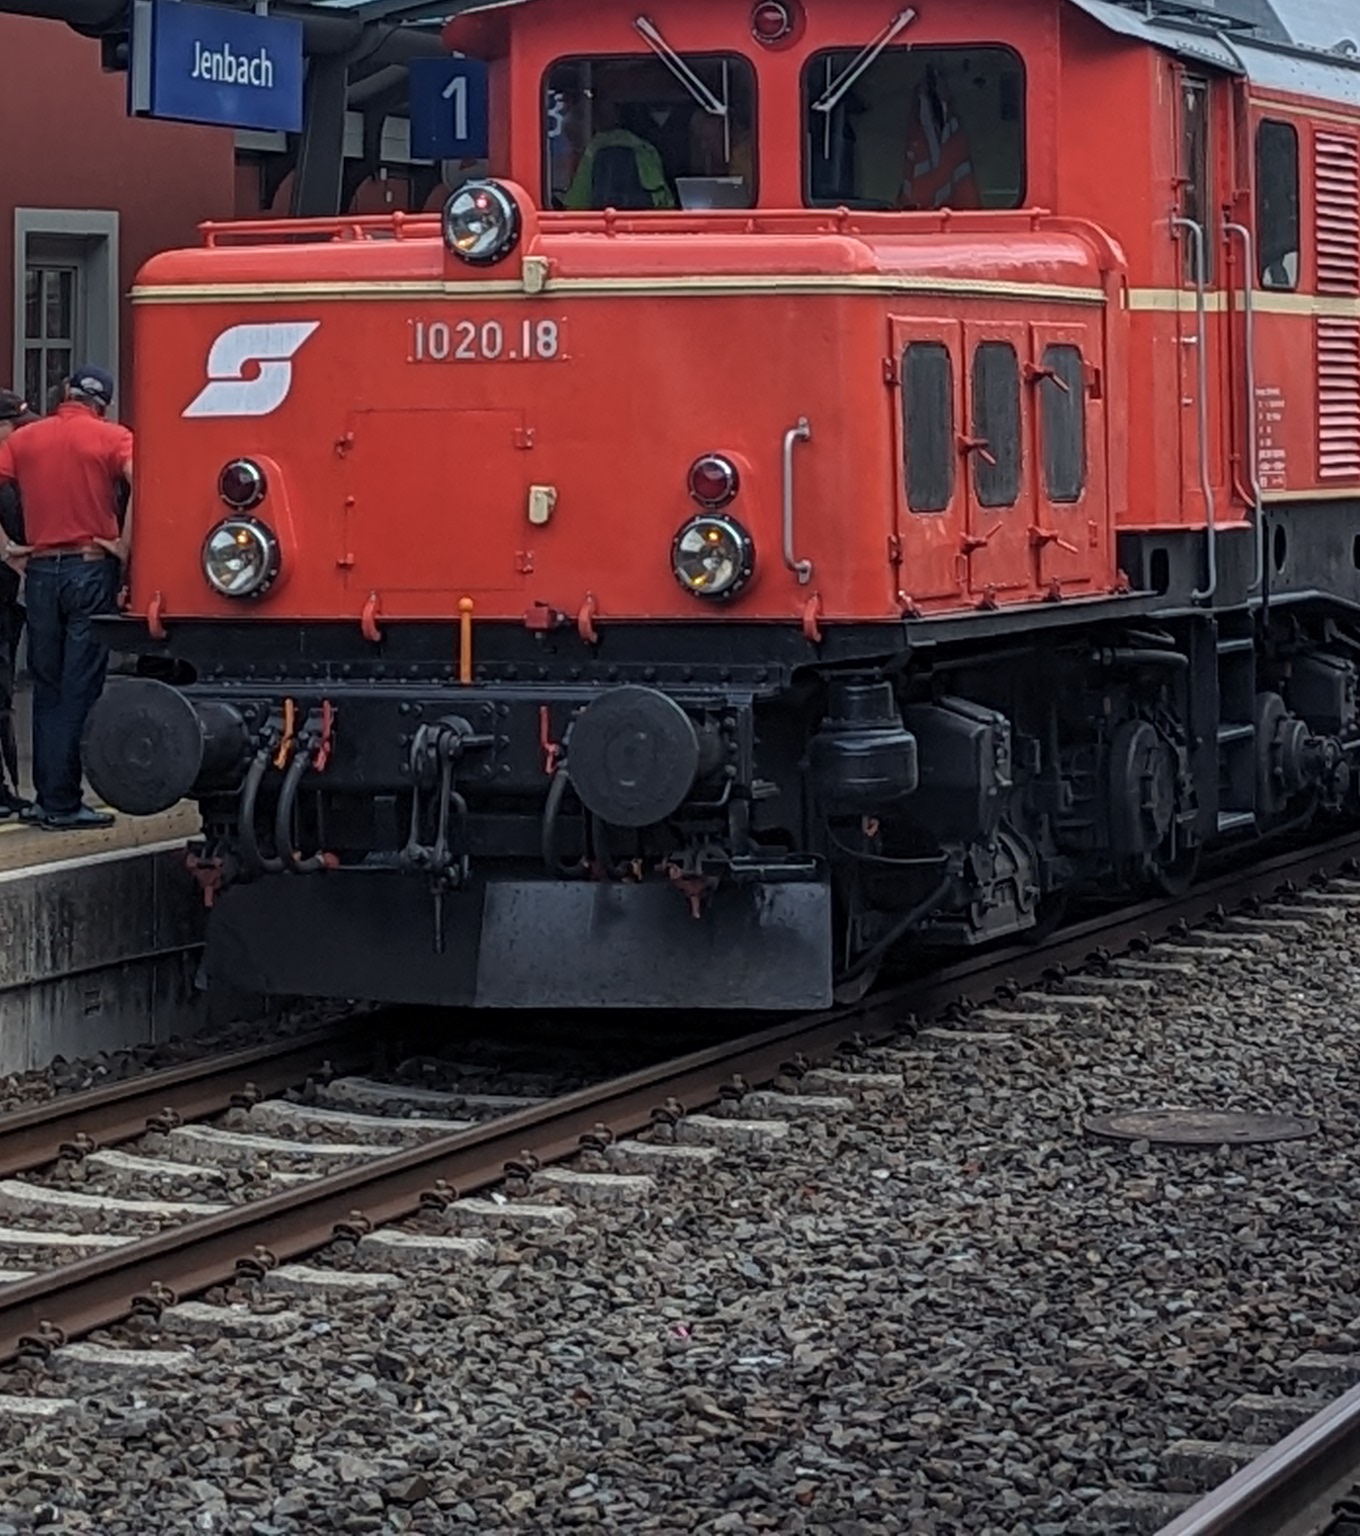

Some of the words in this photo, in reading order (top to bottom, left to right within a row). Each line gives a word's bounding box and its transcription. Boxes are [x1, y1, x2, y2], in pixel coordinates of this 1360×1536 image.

[192, 41, 273, 88] Jenbach
[442, 76, 467, 140] 1
[415, 319, 558, 360] 1020.18
